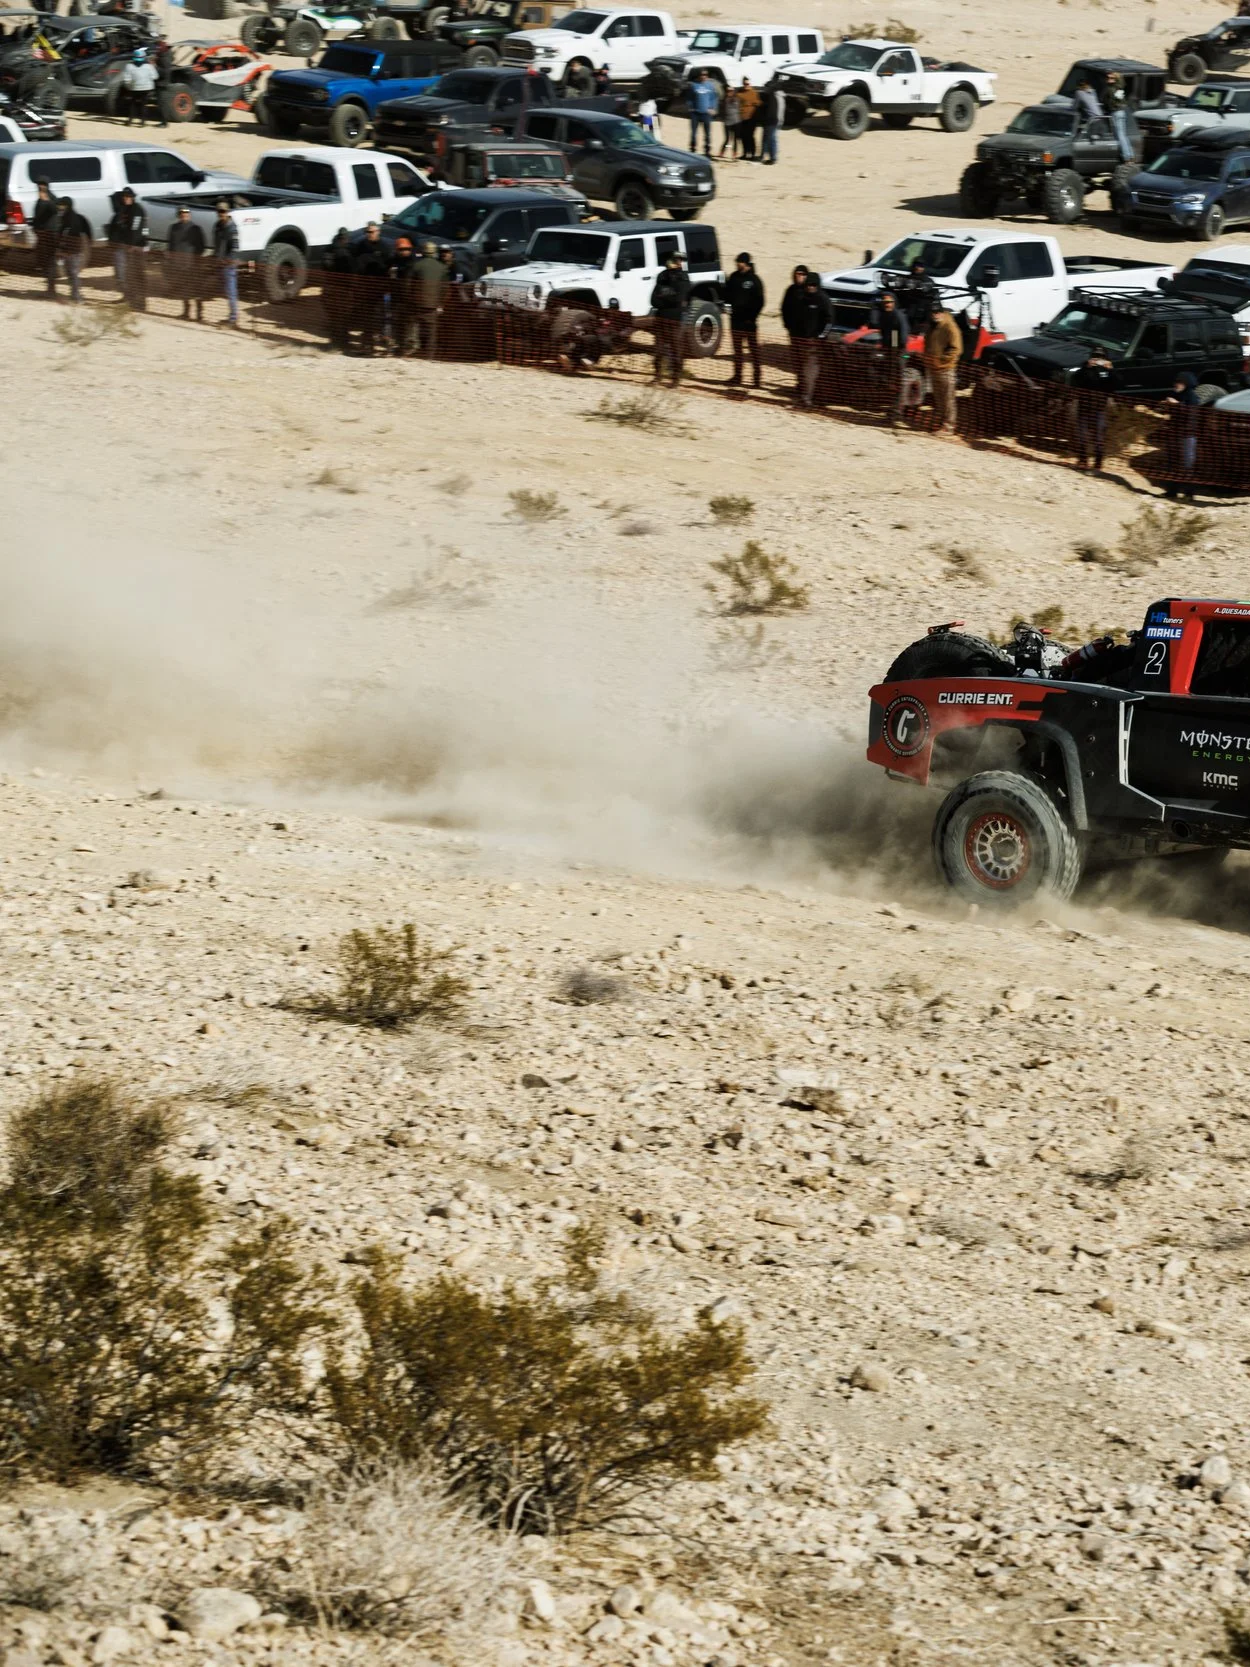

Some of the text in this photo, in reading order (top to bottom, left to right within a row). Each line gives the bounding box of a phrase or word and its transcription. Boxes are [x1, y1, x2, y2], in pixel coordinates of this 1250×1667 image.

[1151, 611, 1184, 625] HP tuners
[1146, 627, 1182, 638] MAHLE
[1143, 641, 1167, 675] 2
[938, 692, 1014, 705] CURRIE ENT.
